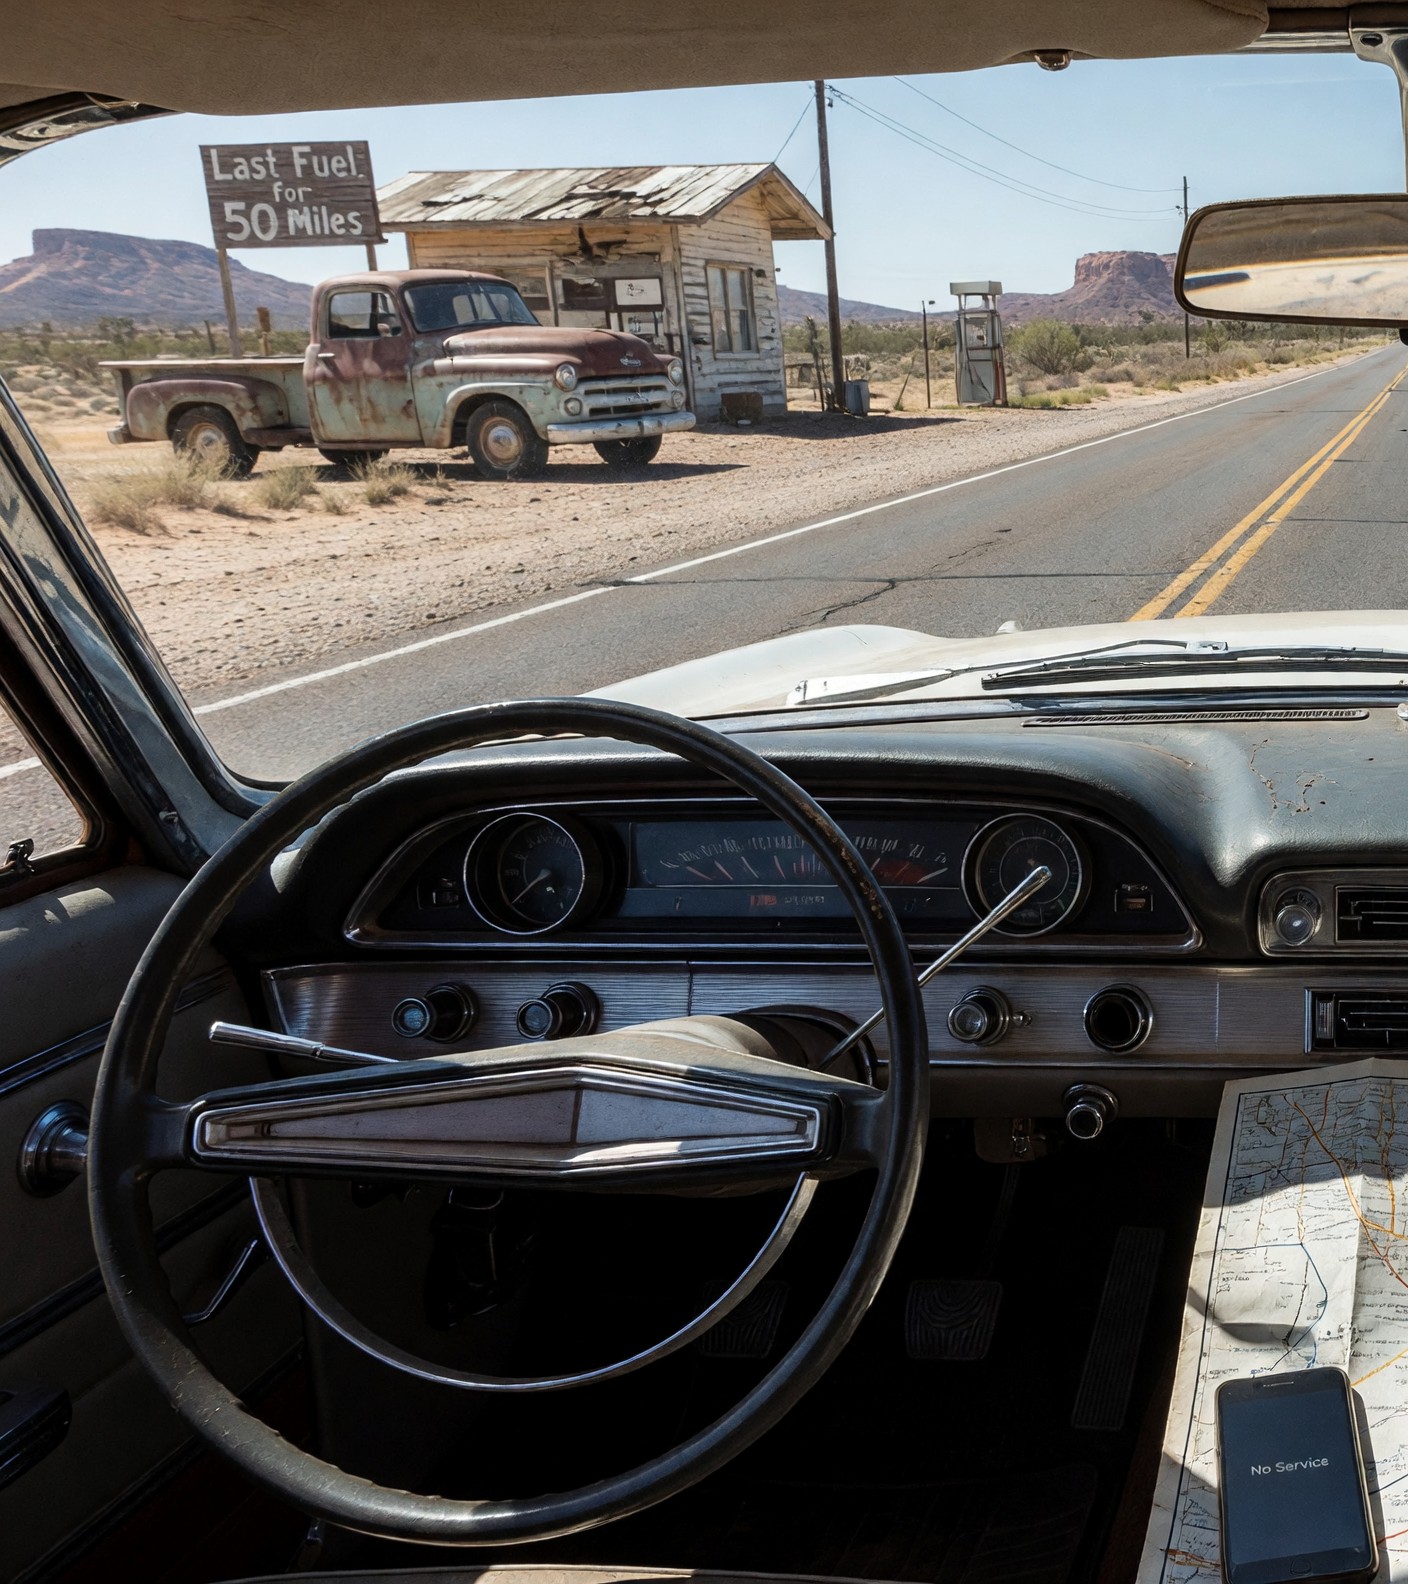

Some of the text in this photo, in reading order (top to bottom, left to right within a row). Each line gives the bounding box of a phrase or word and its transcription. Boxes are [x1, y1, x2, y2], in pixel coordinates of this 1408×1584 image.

[210, 148, 280, 181] Last
[272, 181, 312, 203] for
[223, 201, 363, 242] 50 Miles
[1250, 1457, 1329, 1477] No Service
